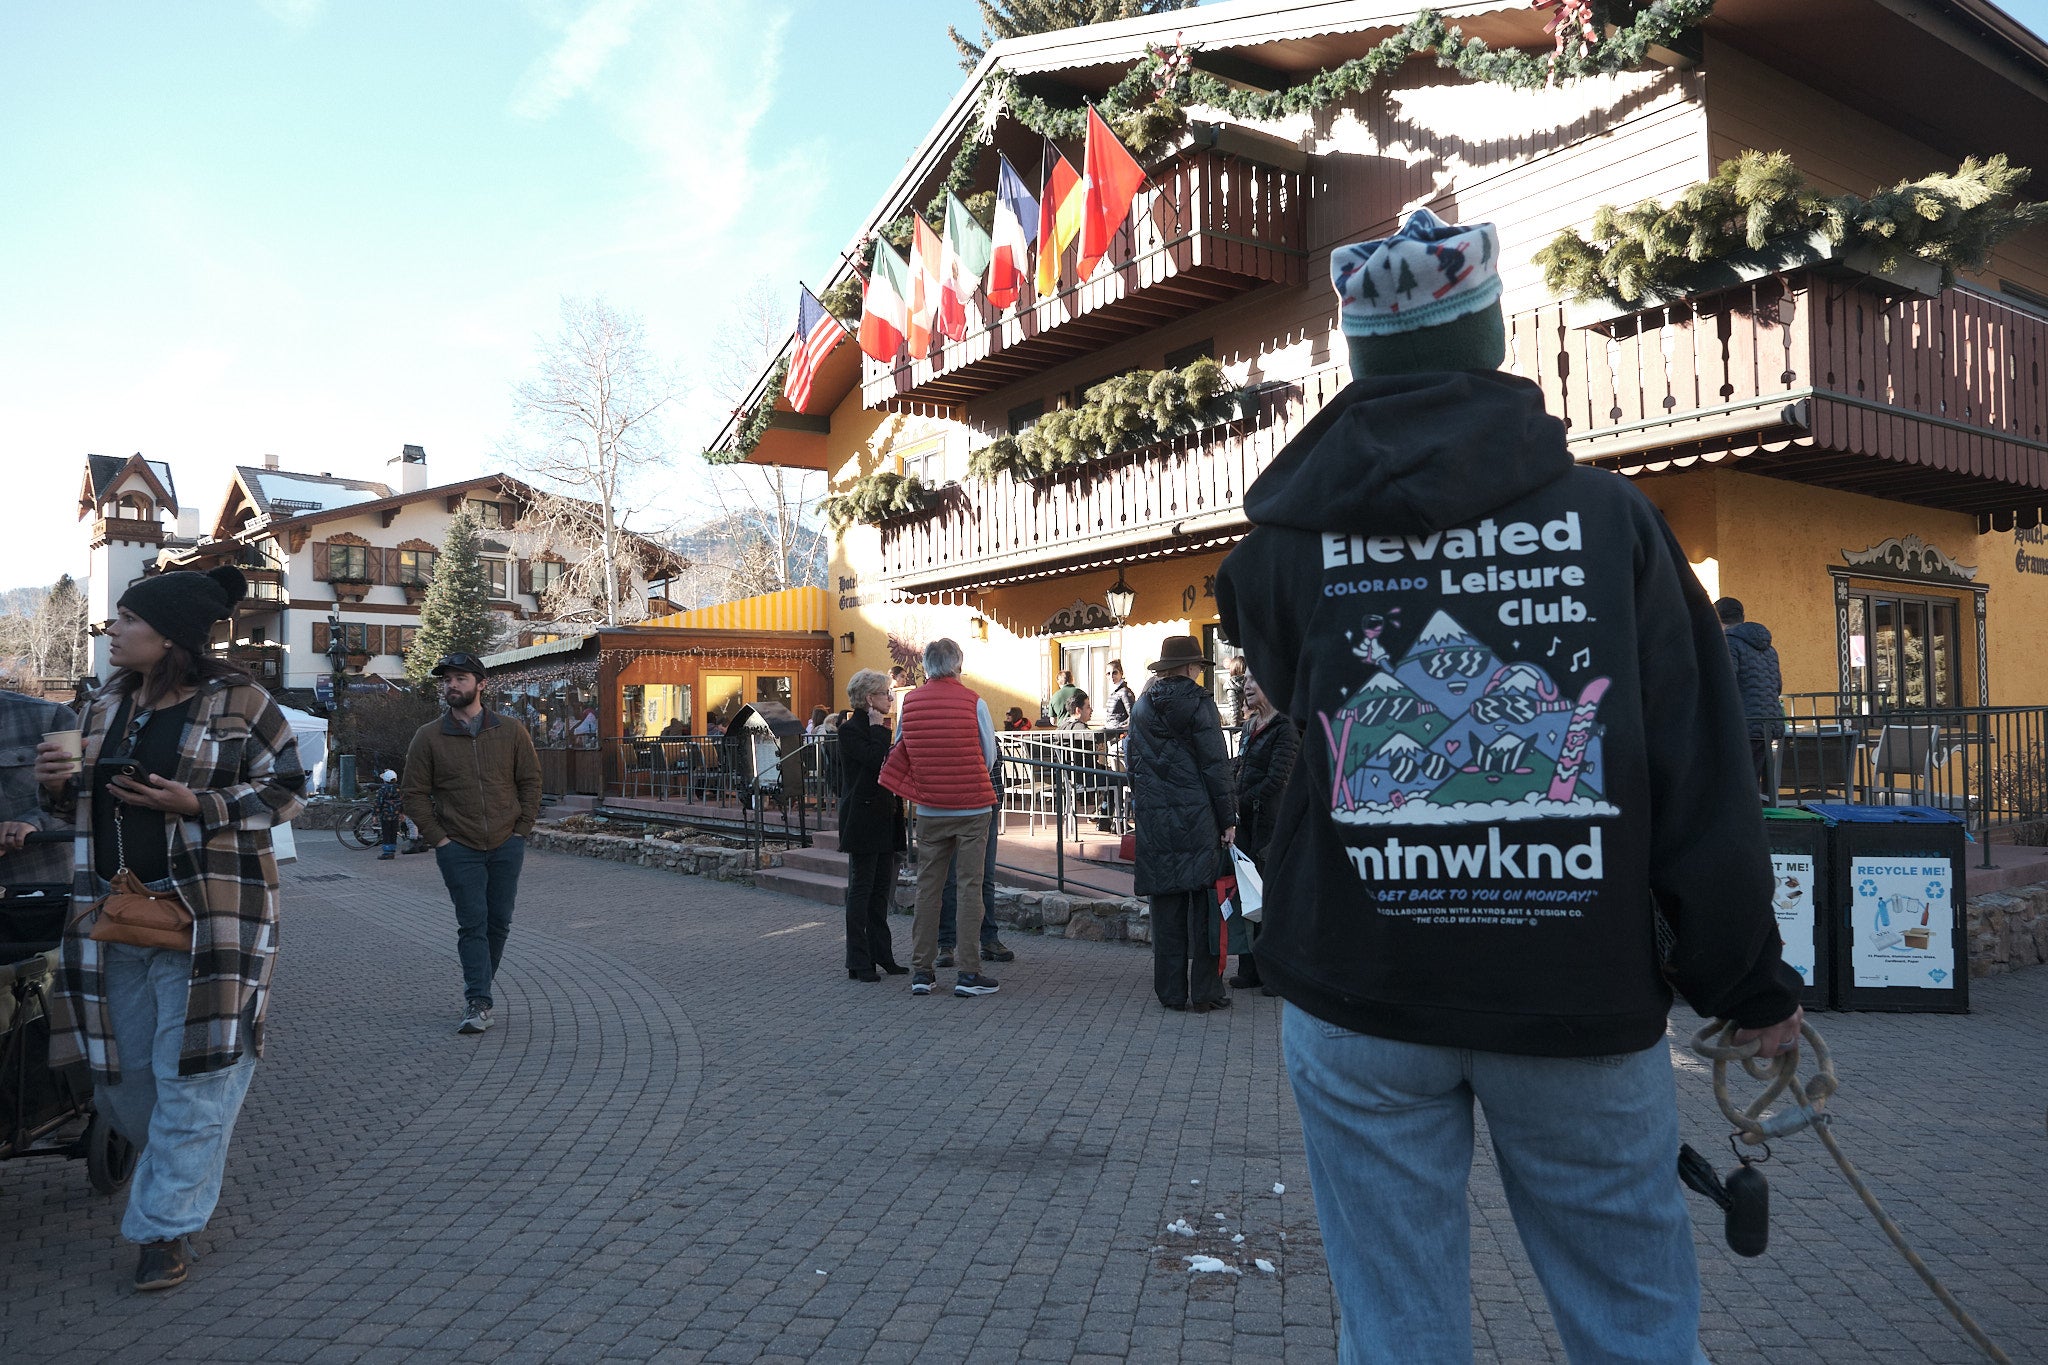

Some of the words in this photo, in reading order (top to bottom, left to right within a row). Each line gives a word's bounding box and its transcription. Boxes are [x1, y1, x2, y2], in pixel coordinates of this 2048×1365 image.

[1321, 511, 1582, 570] Elevated
[1323, 577, 1428, 597] COLORADO
[1440, 564, 1585, 595] Leisure
[1498, 595, 1587, 627] Club
[1345, 826, 1604, 880] mtnwknd
[1786, 862, 1809, 872] ME!
[1857, 866, 1918, 876] RECYCLE
[1922, 867, 1945, 876] ME!
[1378, 889, 1406, 902] GET
[1408, 889, 1446, 901] BACK
[1449, 889, 1468, 900] TO
[1471, 889, 1500, 901] YOU
[1502, 889, 1522, 901] ON
[1448, 907, 1470, 915] WITH
[1507, 908, 1524, 916] ART
[1534, 909, 1567, 917] DESIGN
[1568, 909, 1585, 917] CO.
[1433, 916, 1456, 924] COLD
[1458, 916, 1498, 924] WEATHER
